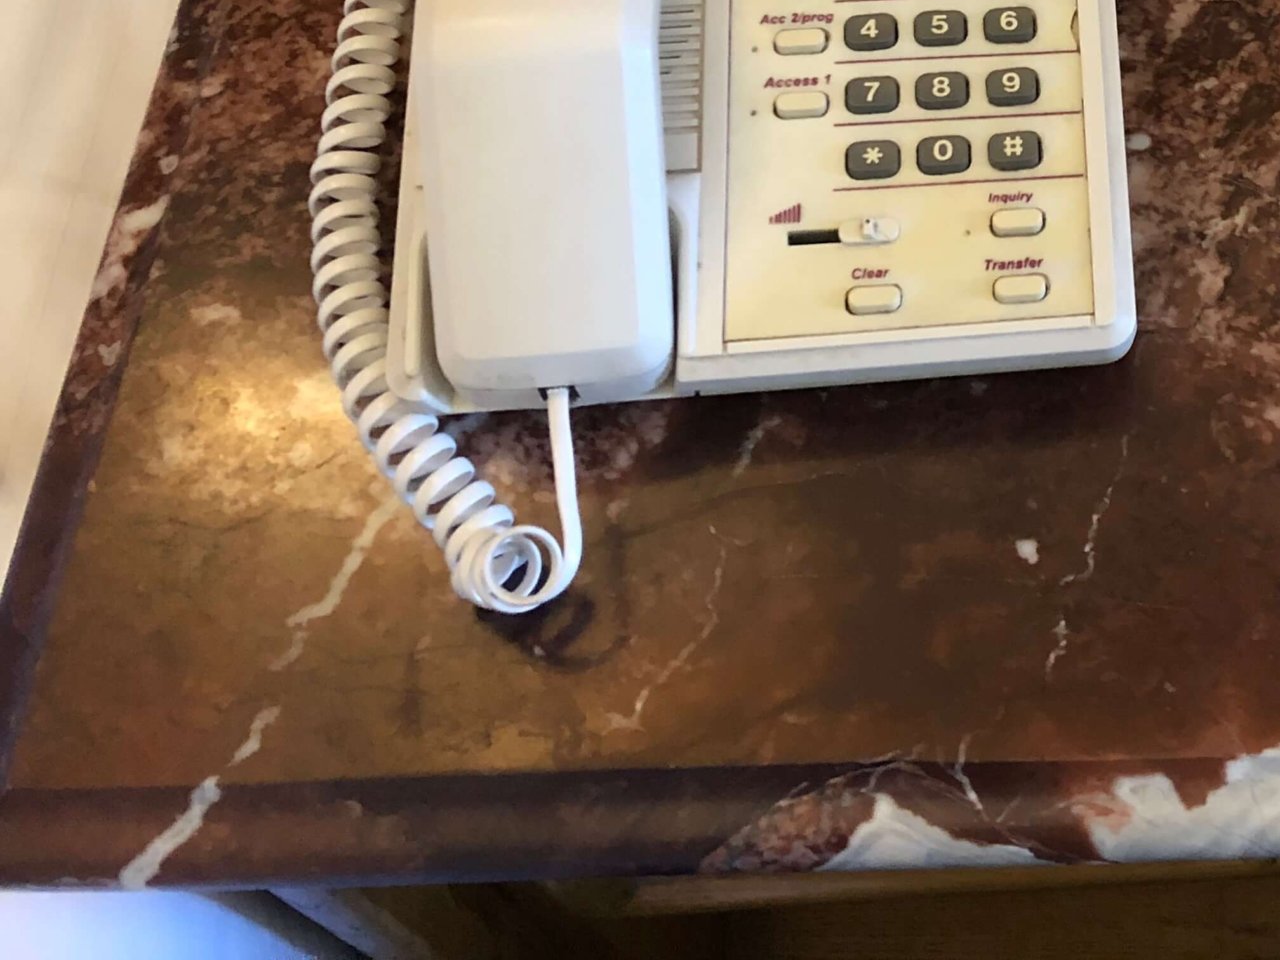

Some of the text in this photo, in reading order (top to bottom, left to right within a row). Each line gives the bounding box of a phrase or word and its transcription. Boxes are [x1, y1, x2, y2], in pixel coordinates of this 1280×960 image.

[760, 14, 786, 24] Acc
[860, 19, 878, 37] 4
[930, 15, 948, 33] 5
[1000, 11, 1018, 30] 6
[764, 76, 819, 88] Access
[932, 77, 951, 96] 8
[1002, 72, 1021, 92] 9
[863, 82, 880, 101] 7
[932, 139, 953, 160] 0
[1003, 136, 1023, 156] #
[988, 192, 1033, 203] Inquiry
[984, 257, 1043, 271] Transfer
[851, 268, 889, 279] Clear
